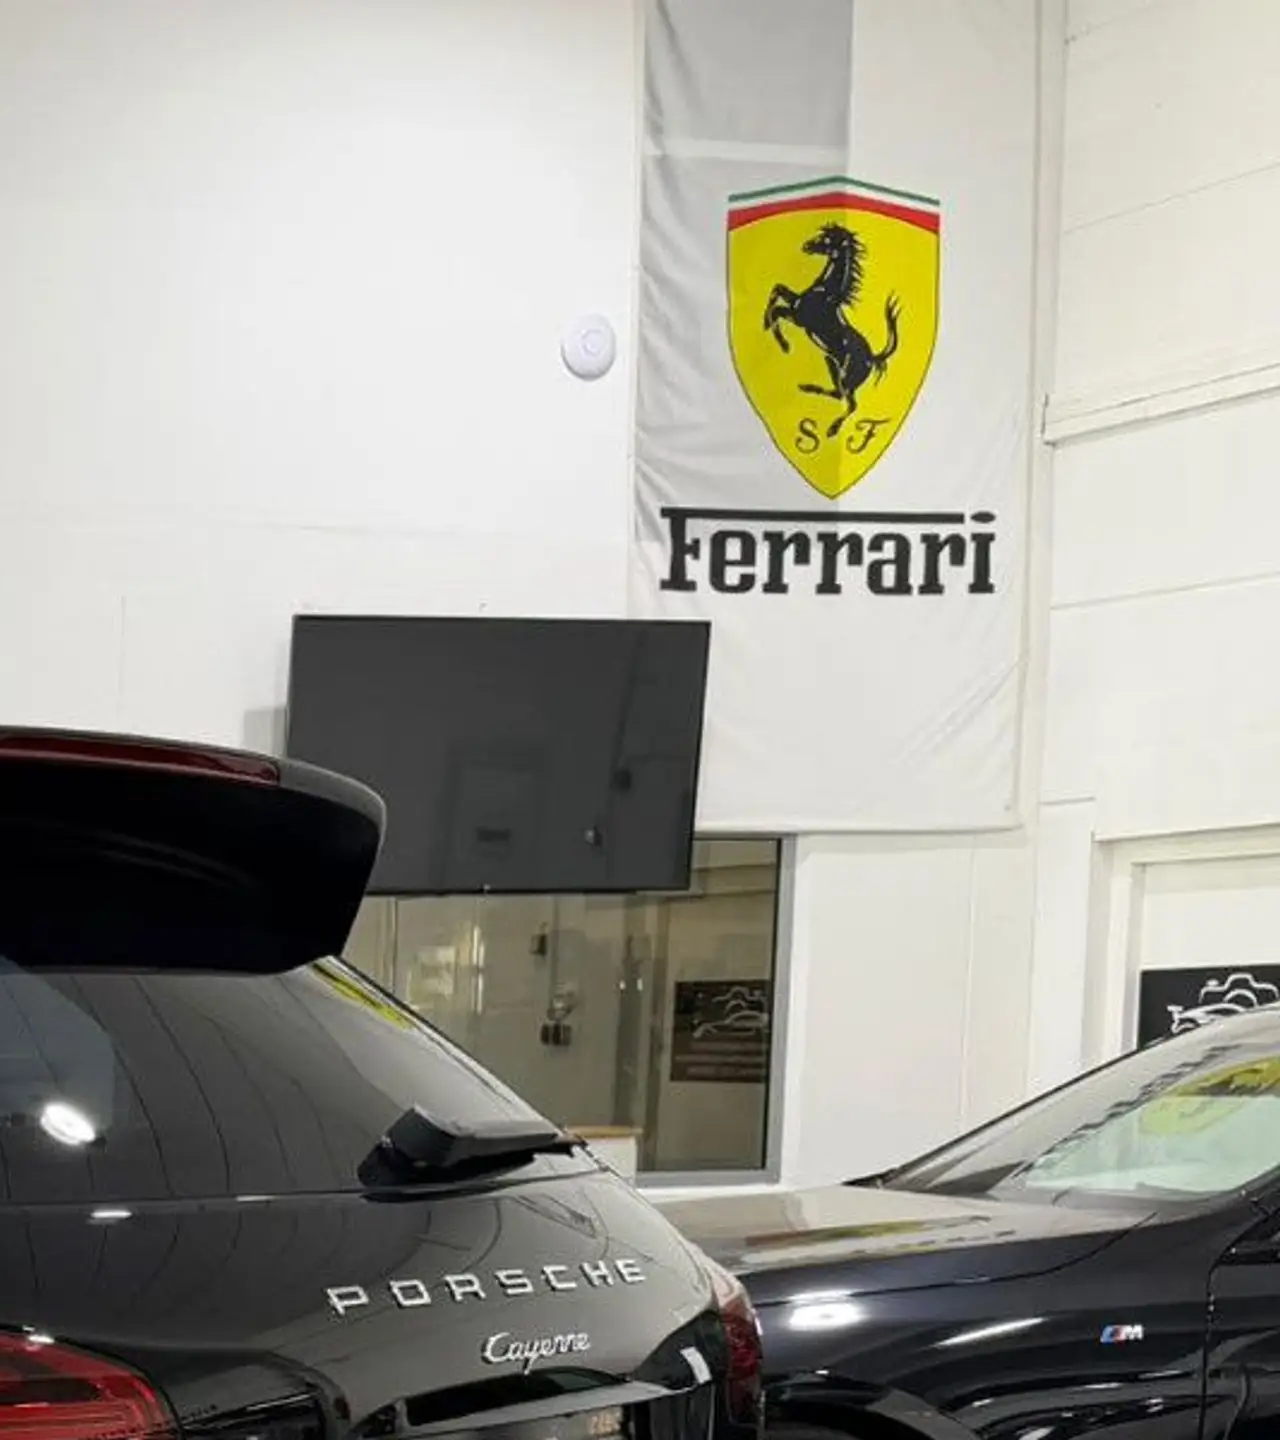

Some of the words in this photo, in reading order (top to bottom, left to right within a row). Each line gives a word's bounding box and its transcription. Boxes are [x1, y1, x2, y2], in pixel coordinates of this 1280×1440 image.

[794, 418, 821, 454] S
[659, 506, 997, 595] Ferrari
[326, 1257, 650, 1320] PORSCHE
[481, 1330, 592, 1375] Cayenne
